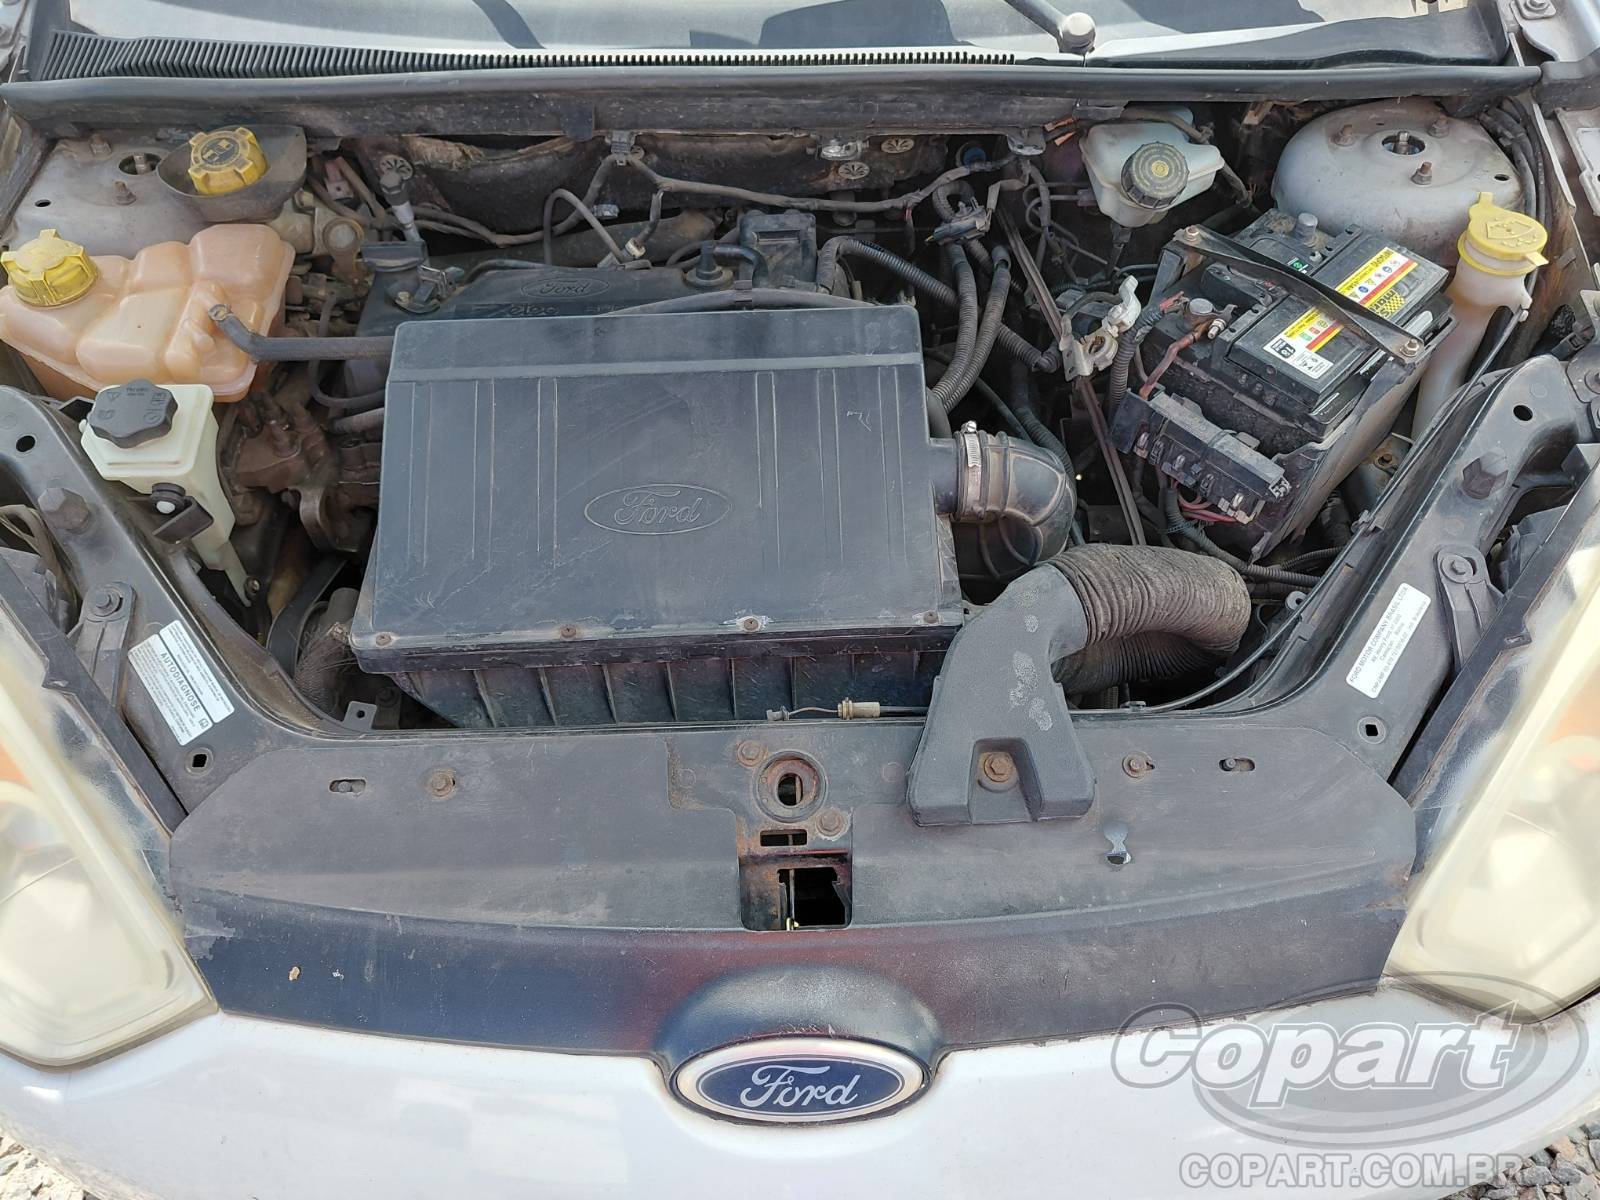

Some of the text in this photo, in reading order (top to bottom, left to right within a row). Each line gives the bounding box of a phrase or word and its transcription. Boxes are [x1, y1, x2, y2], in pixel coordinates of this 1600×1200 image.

[613, 490, 704, 526] Ford
[1349, 666, 1361, 682] FORD
[1359, 647, 1373, 666] MOTOR
[1371, 621, 1388, 647] COMPANY
[160, 651, 201, 713] AUTODIAGNOSE
[739, 1065, 861, 1108] Ford
